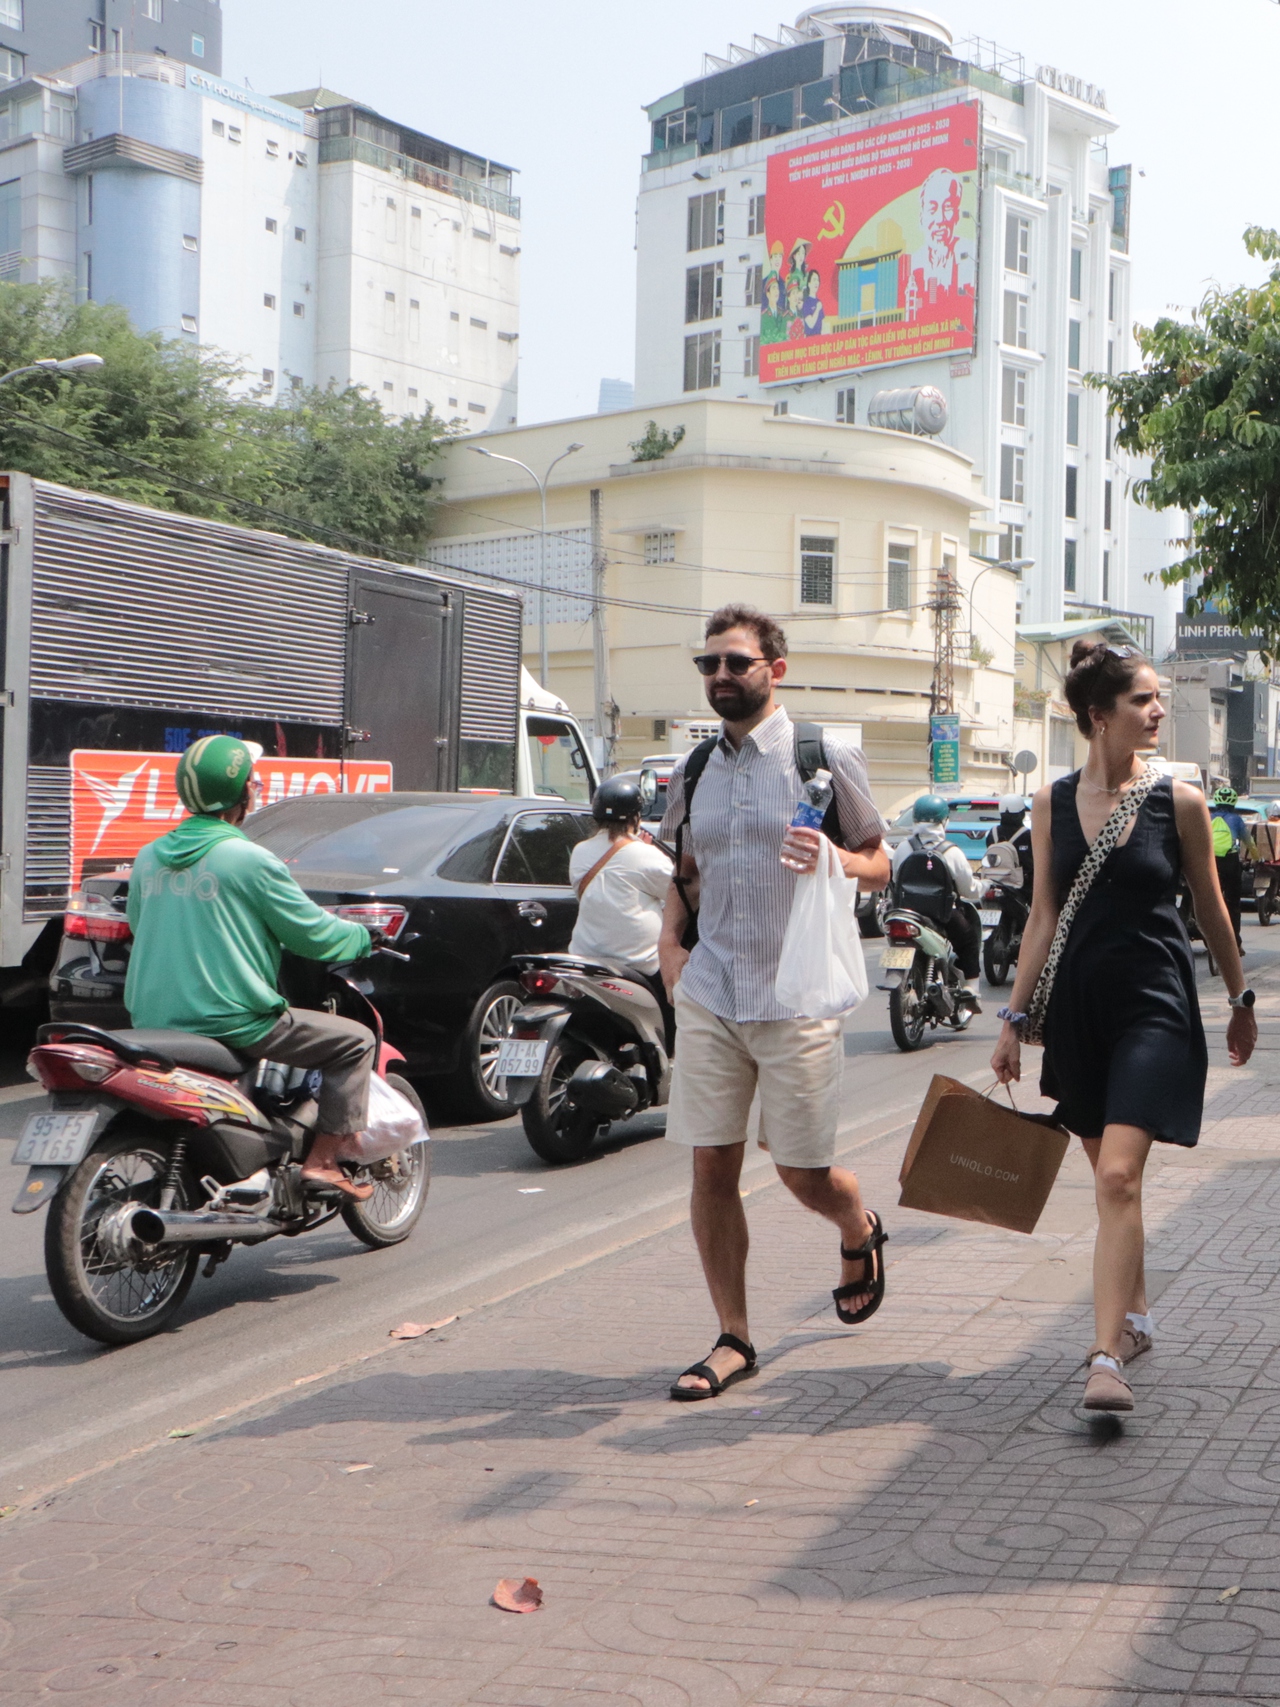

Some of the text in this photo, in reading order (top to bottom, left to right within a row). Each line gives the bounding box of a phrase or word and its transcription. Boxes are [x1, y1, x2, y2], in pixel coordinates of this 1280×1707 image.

[1178, 626, 1206, 637] LINH
[226, 748, 245, 778] Grab
[506, 1043, 538, 1058] 71-AK
[500, 1059, 539, 1073] 057.99
[33, 1116, 82, 1136] 95-F5
[23, 1139, 76, 1160] 3165
[950, 1154, 1020, 1183] UNIQLO.COM
